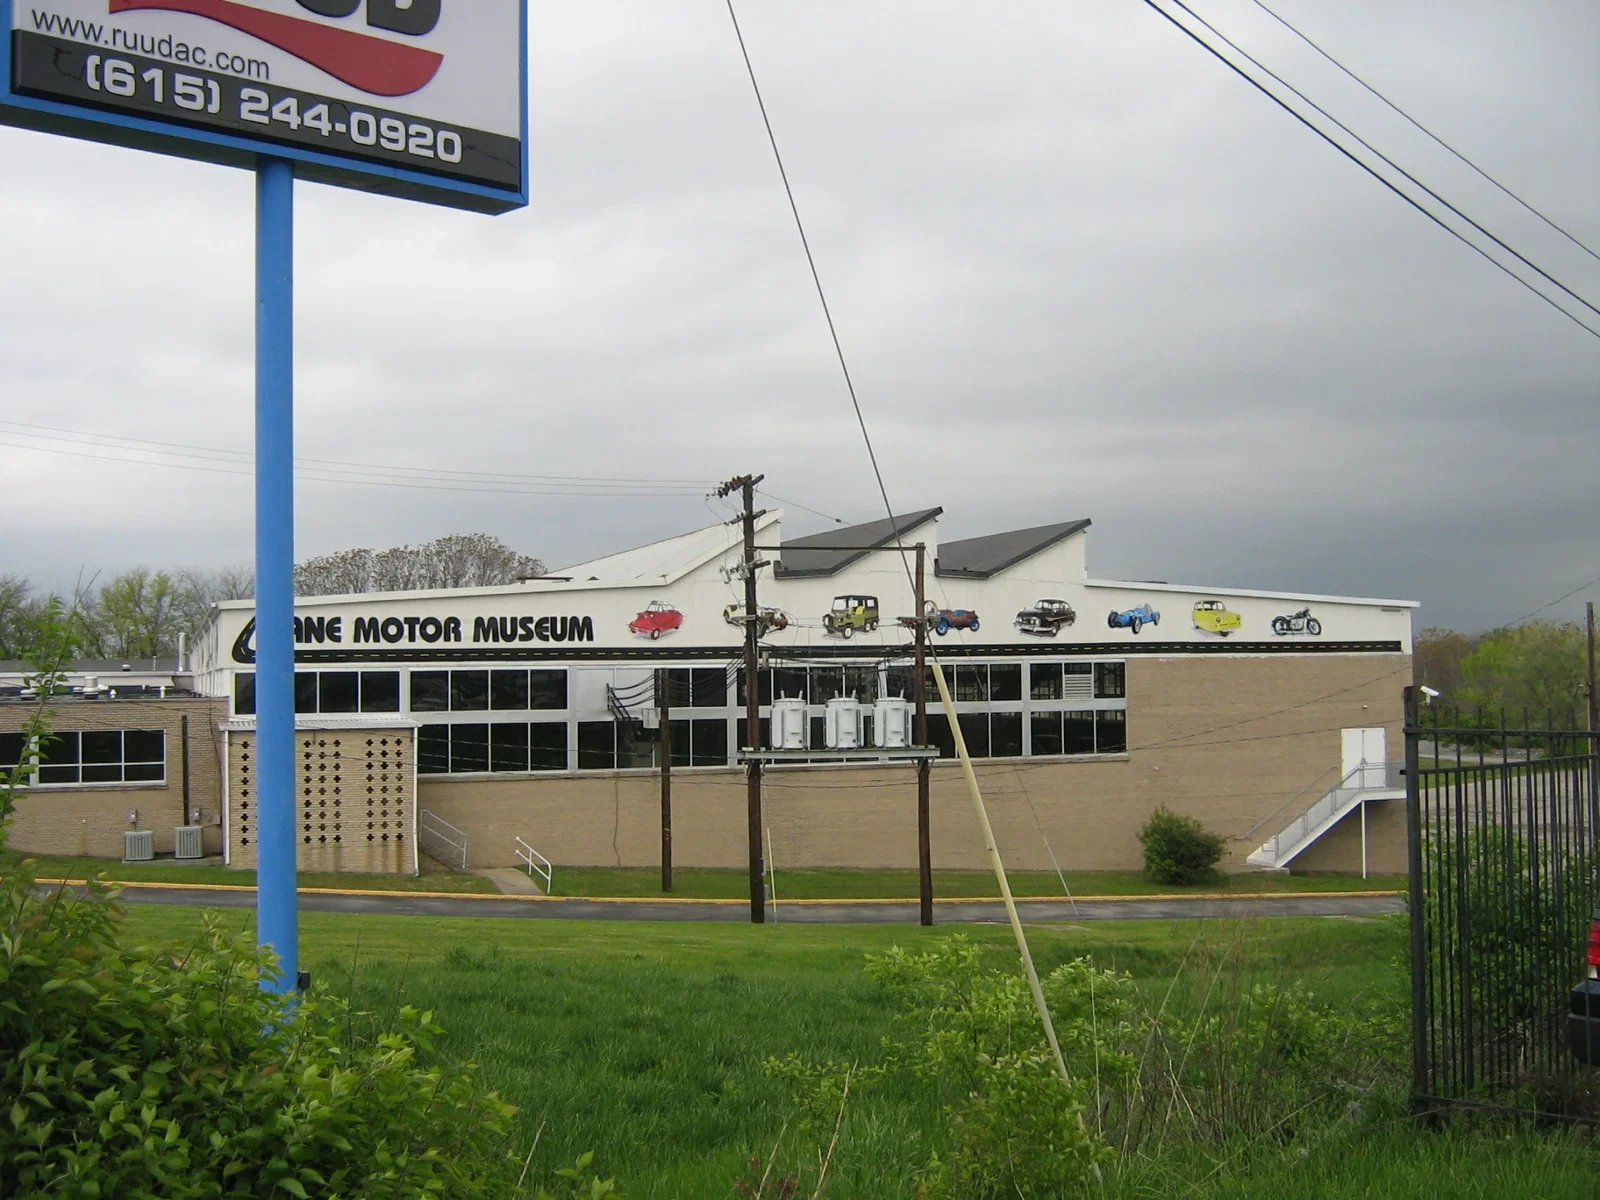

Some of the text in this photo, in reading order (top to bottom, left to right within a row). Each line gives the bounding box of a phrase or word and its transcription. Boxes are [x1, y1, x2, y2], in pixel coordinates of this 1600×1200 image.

[31, 8, 270, 80] www.ruudac.com
[86, 54, 462, 164] (615) 244-0920
[353, 616, 462, 643] MOTOR
[472, 615, 594, 642] MUSEUM
